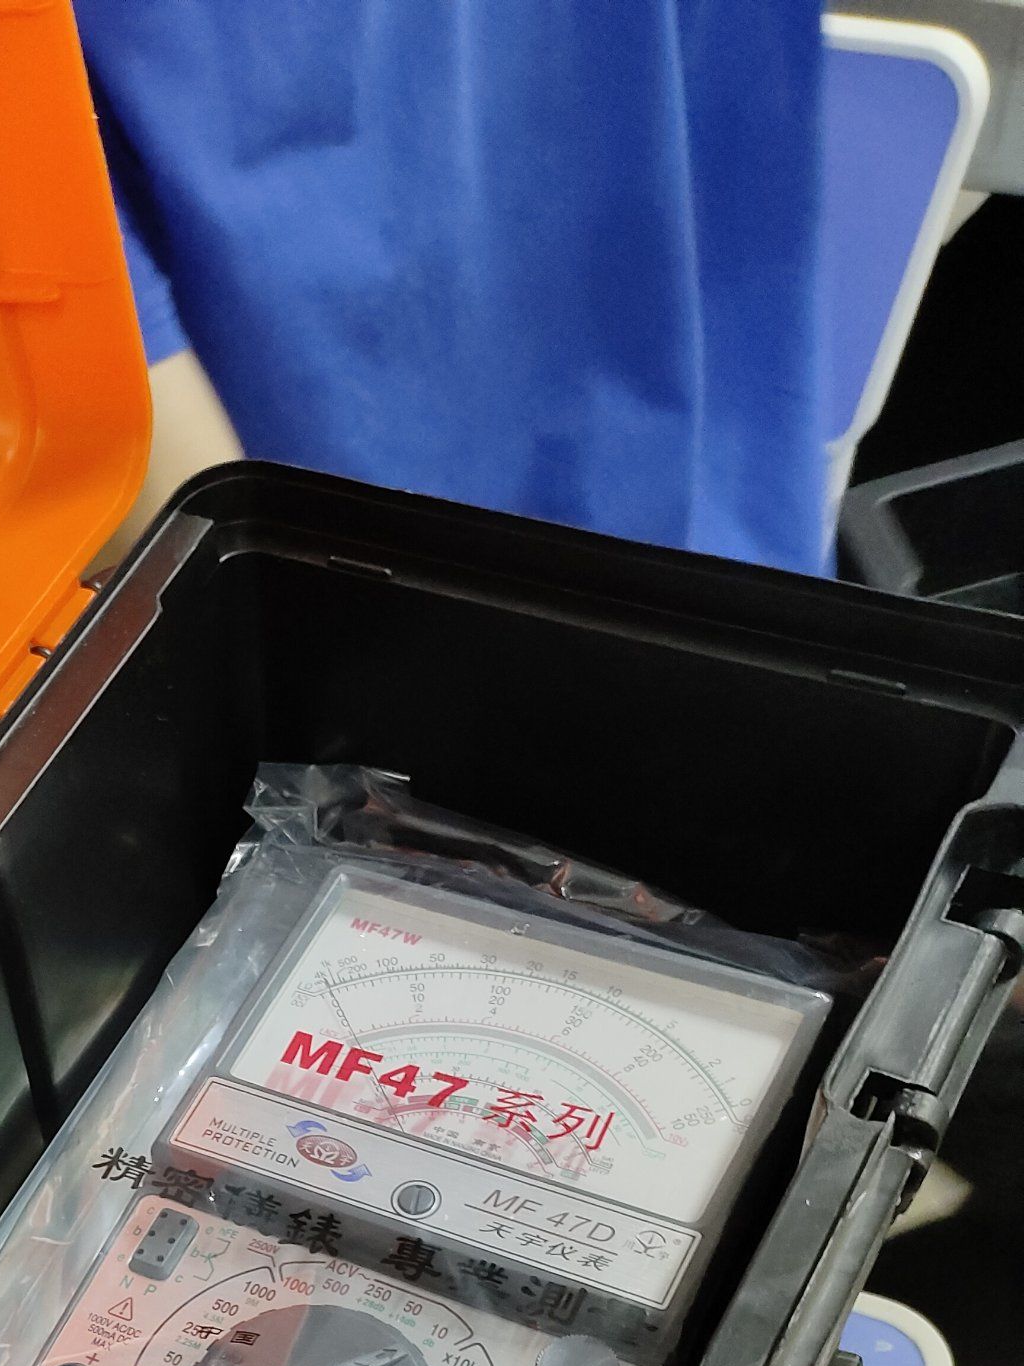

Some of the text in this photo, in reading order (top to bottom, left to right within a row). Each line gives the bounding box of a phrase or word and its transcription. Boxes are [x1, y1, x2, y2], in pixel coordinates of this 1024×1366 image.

[350, 918, 422, 946] MF47W
[338, 956, 358, 968] 500
[376, 957, 398, 968] 100
[429, 953, 446, 963] 50
[480, 953, 497, 964] 30
[526, 960, 544, 972] 20
[562, 969, 578, 981] 15
[409, 983, 426, 993] 50
[490, 985, 512, 997] 100
[606, 986, 623, 998] 10
[412, 993, 425, 1003] 10
[488, 996, 506, 1007] 20
[565, 1015, 583, 1028] 30
[280, 1030, 616, 1151] MF47 系列
[209, 1116, 278, 1147] MULTIPLE
[202, 1128, 299, 1168] PROTECTION
[482, 1189, 616, 1243] MF 47D
[247, 1238, 281, 1254] 2500V
[479, 1220, 614, 1271] 天宇仪表
[119, 1275, 157, 1296] N P
[242, 1281, 276, 1302] 1000
[282, 1276, 316, 1297] 1000
[322, 1278, 350, 1296] 500
[364, 1283, 393, 1302] 250
[212, 1298, 240, 1317] 500
[403, 1301, 423, 1317] 50
[87, 1312, 114, 1328] 1000V
[87, 1323, 116, 1341] 500mA
[431, 1323, 449, 1340] 10
[91, 1336, 113, 1352] MAX
[163, 1350, 183, 1366] 50
